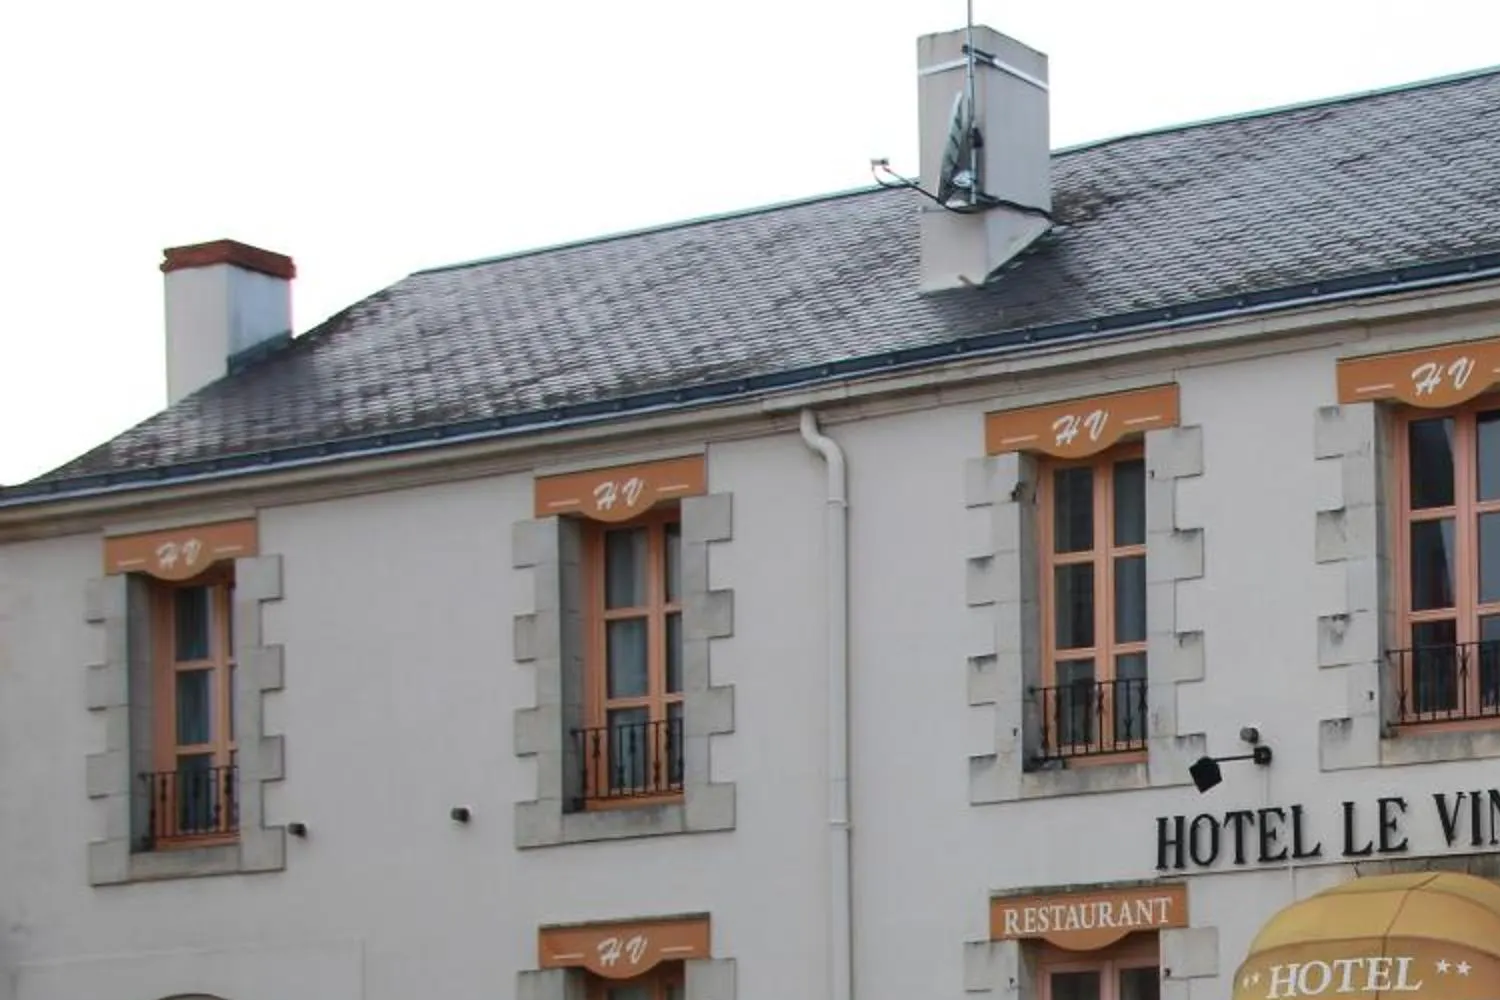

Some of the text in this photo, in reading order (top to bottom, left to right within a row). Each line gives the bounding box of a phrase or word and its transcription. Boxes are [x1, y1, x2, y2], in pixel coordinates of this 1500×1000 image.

[1156, 804, 1322, 870] HOTEL
[1342, 797, 1409, 857] LE
[1002, 896, 1173, 936] RESTAURANT
[1265, 956, 1423, 1000] HOTEL
